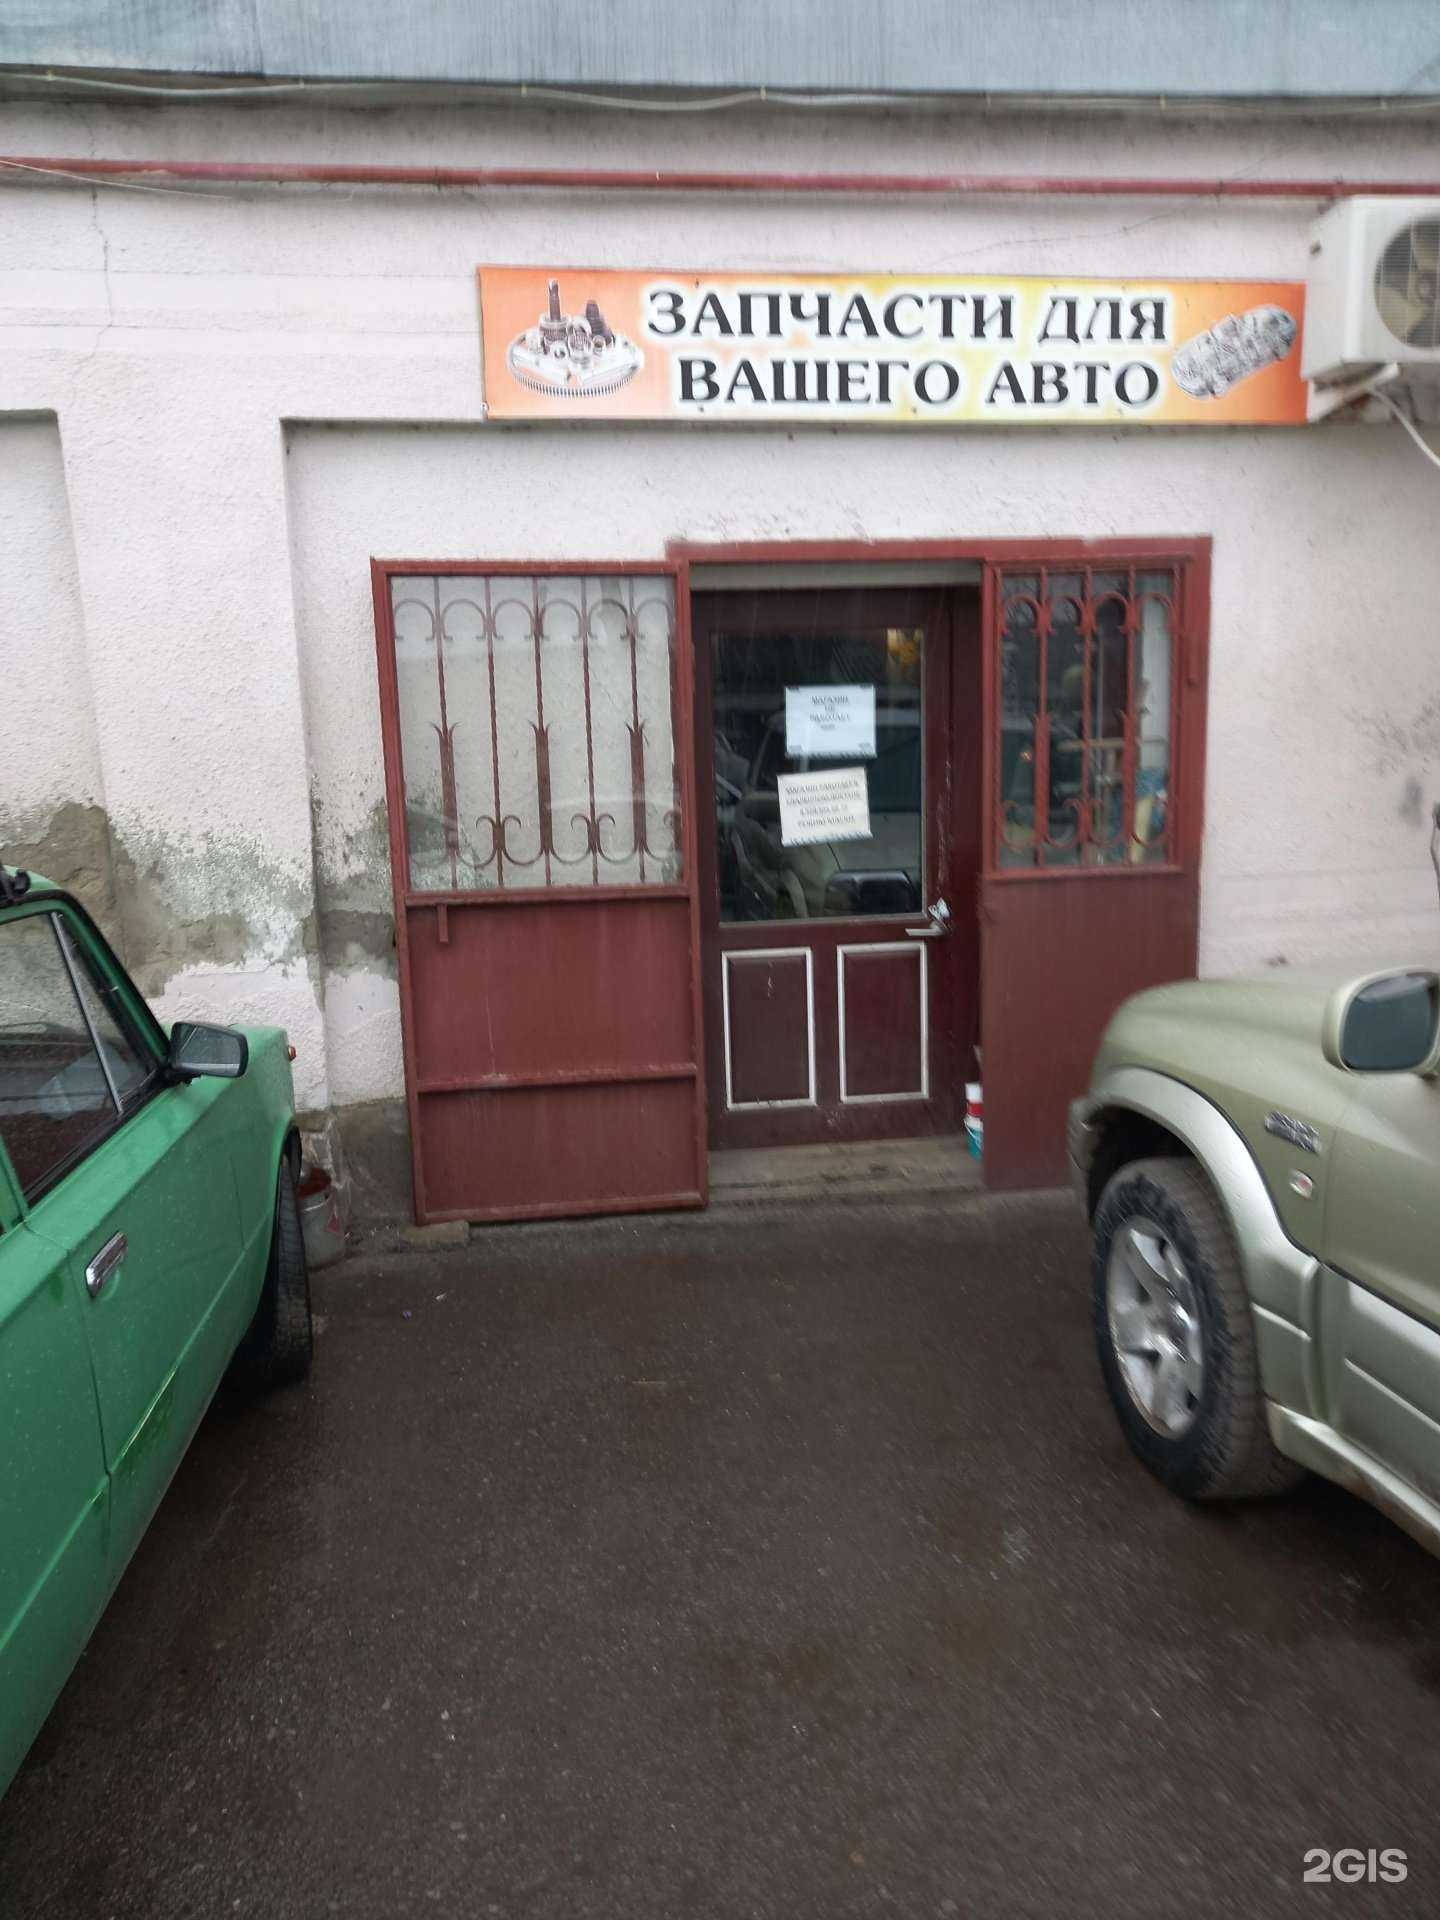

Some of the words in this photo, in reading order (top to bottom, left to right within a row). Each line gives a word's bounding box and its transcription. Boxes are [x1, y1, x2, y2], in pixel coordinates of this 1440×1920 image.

[648, 290, 1014, 339] ЗАПЧАСТИ
[1037, 296, 1167, 344] ДЛЯ
[678, 357, 960, 404] ВАШЕГО
[984, 360, 1160, 408] АВТО
